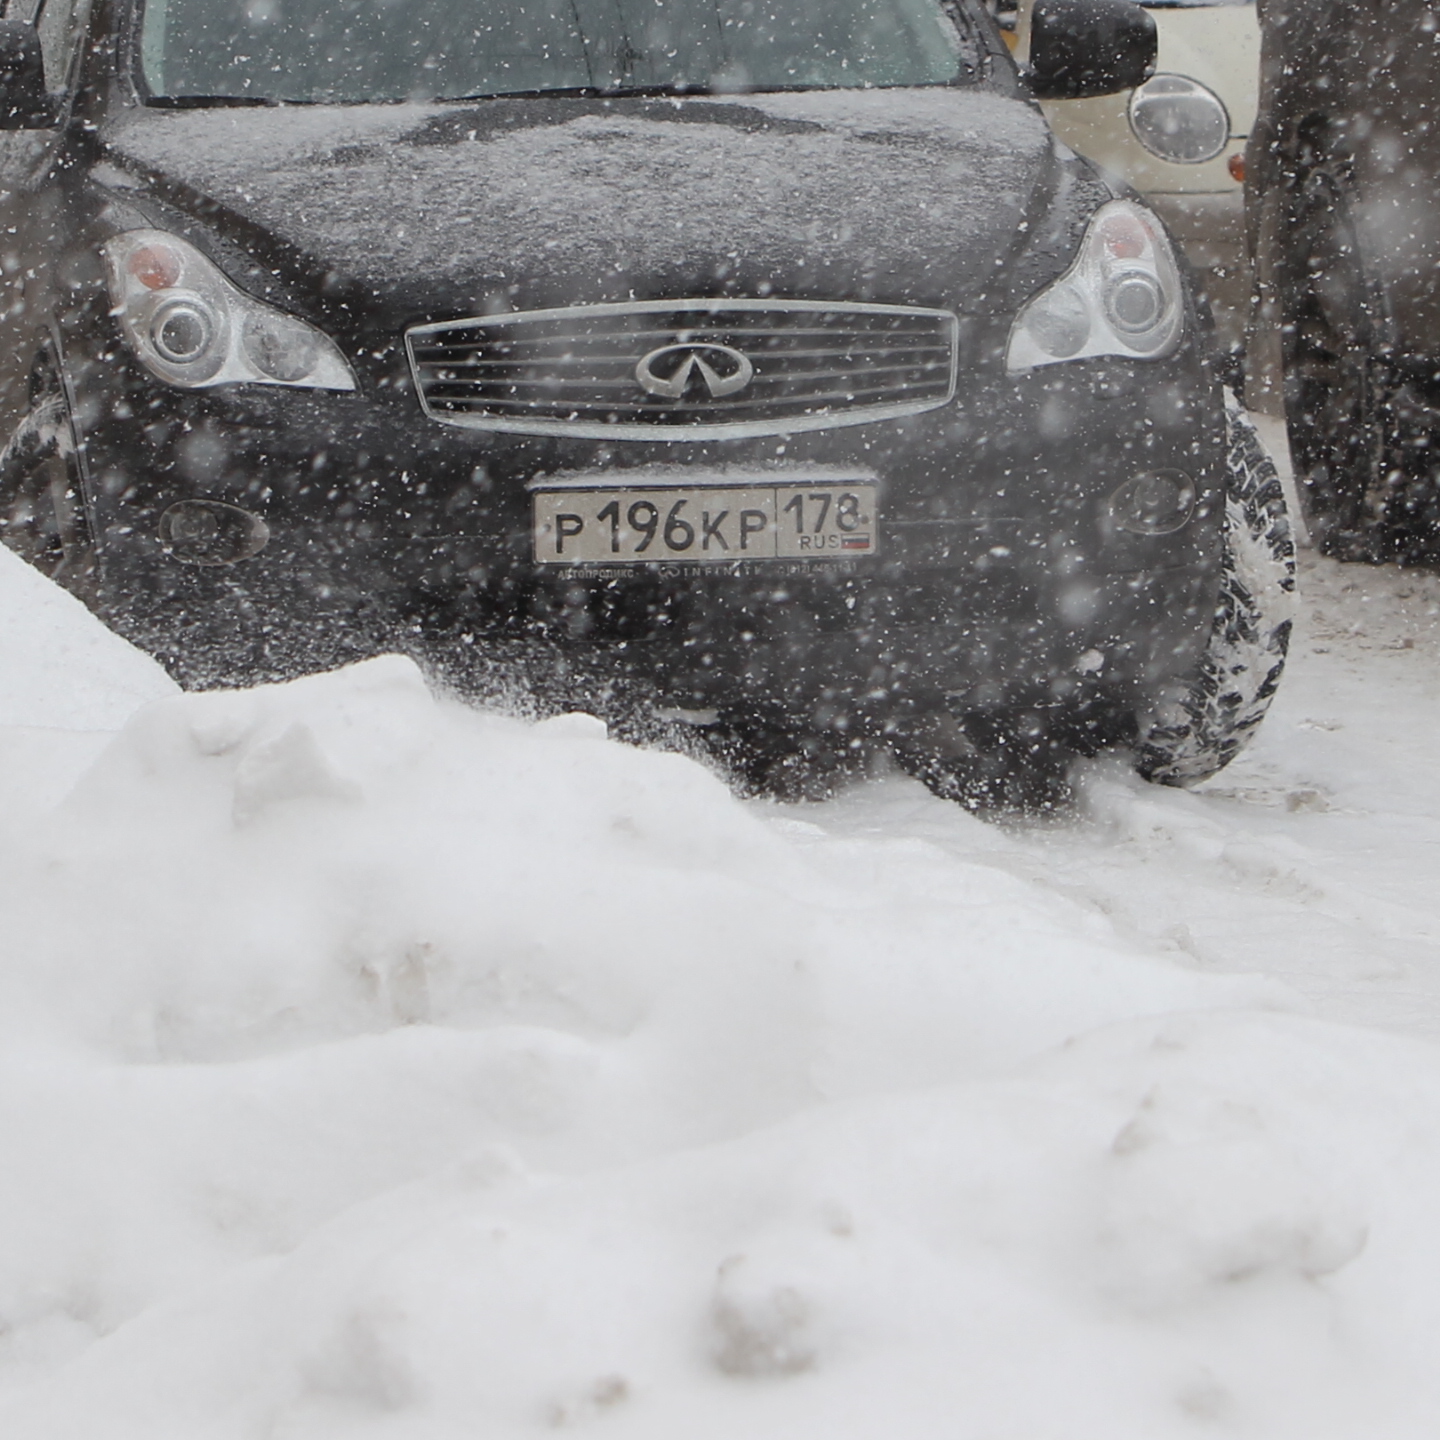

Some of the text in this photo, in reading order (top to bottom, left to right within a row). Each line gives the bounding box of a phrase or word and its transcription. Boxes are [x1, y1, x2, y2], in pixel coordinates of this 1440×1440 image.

[555, 493, 859, 554] Р196КР 178
[800, 534, 840, 550] RUS
